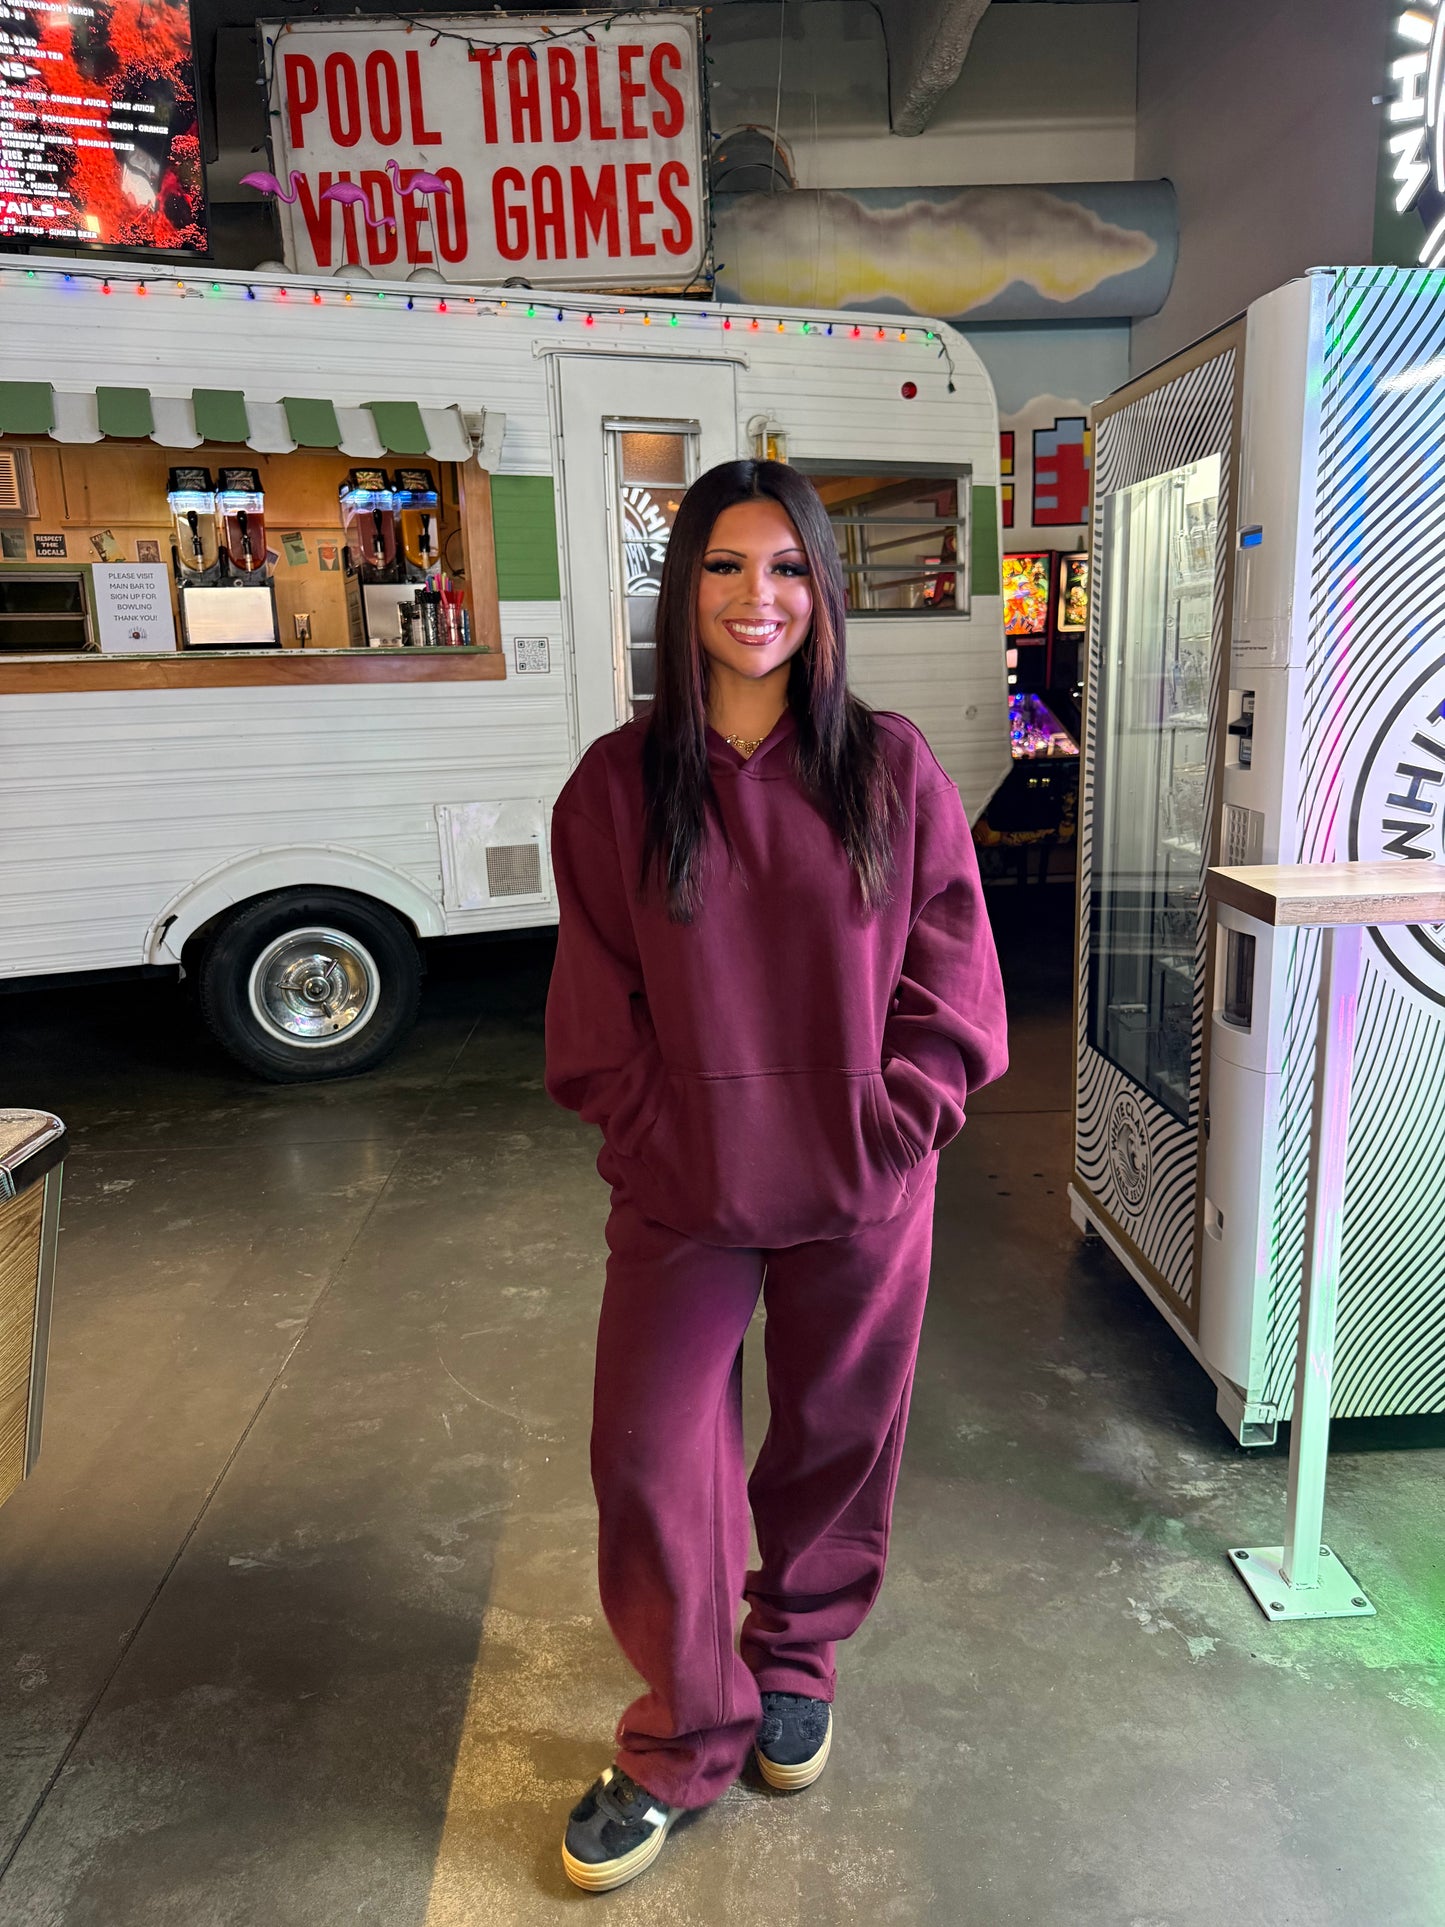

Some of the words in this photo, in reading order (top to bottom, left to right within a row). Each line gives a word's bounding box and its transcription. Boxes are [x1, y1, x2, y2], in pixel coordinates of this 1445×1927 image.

[68, 5, 95, 17] PEACH
[19, 47, 46, 58] PEACH
[47, 52, 64, 61] TEA
[23, 91, 47, 101] JUICE
[51, 94, 82, 105] ORANGE
[112, 101, 131, 111] LIME
[132, 104, 156, 113] JUICE
[284, 49, 443, 149] POOL
[468, 42, 685, 145] TABLES
[107, 121, 134, 131] LEMON
[138, 124, 169, 135] ORANGE
[1, 138, 45, 151] PINEAPPLE
[77, 138, 110, 149] BANANA
[30, 182, 59, 191] MANGO
[300, 166, 469, 267] VIDEO
[491, 160, 693, 261] GAMES
[108, 572, 135, 580] PLEASE
[136, 572, 154, 580] VISIT
[1111, 1101, 1126, 1151] WHITE
[1126, 1101, 1147, 1147] CLAW
